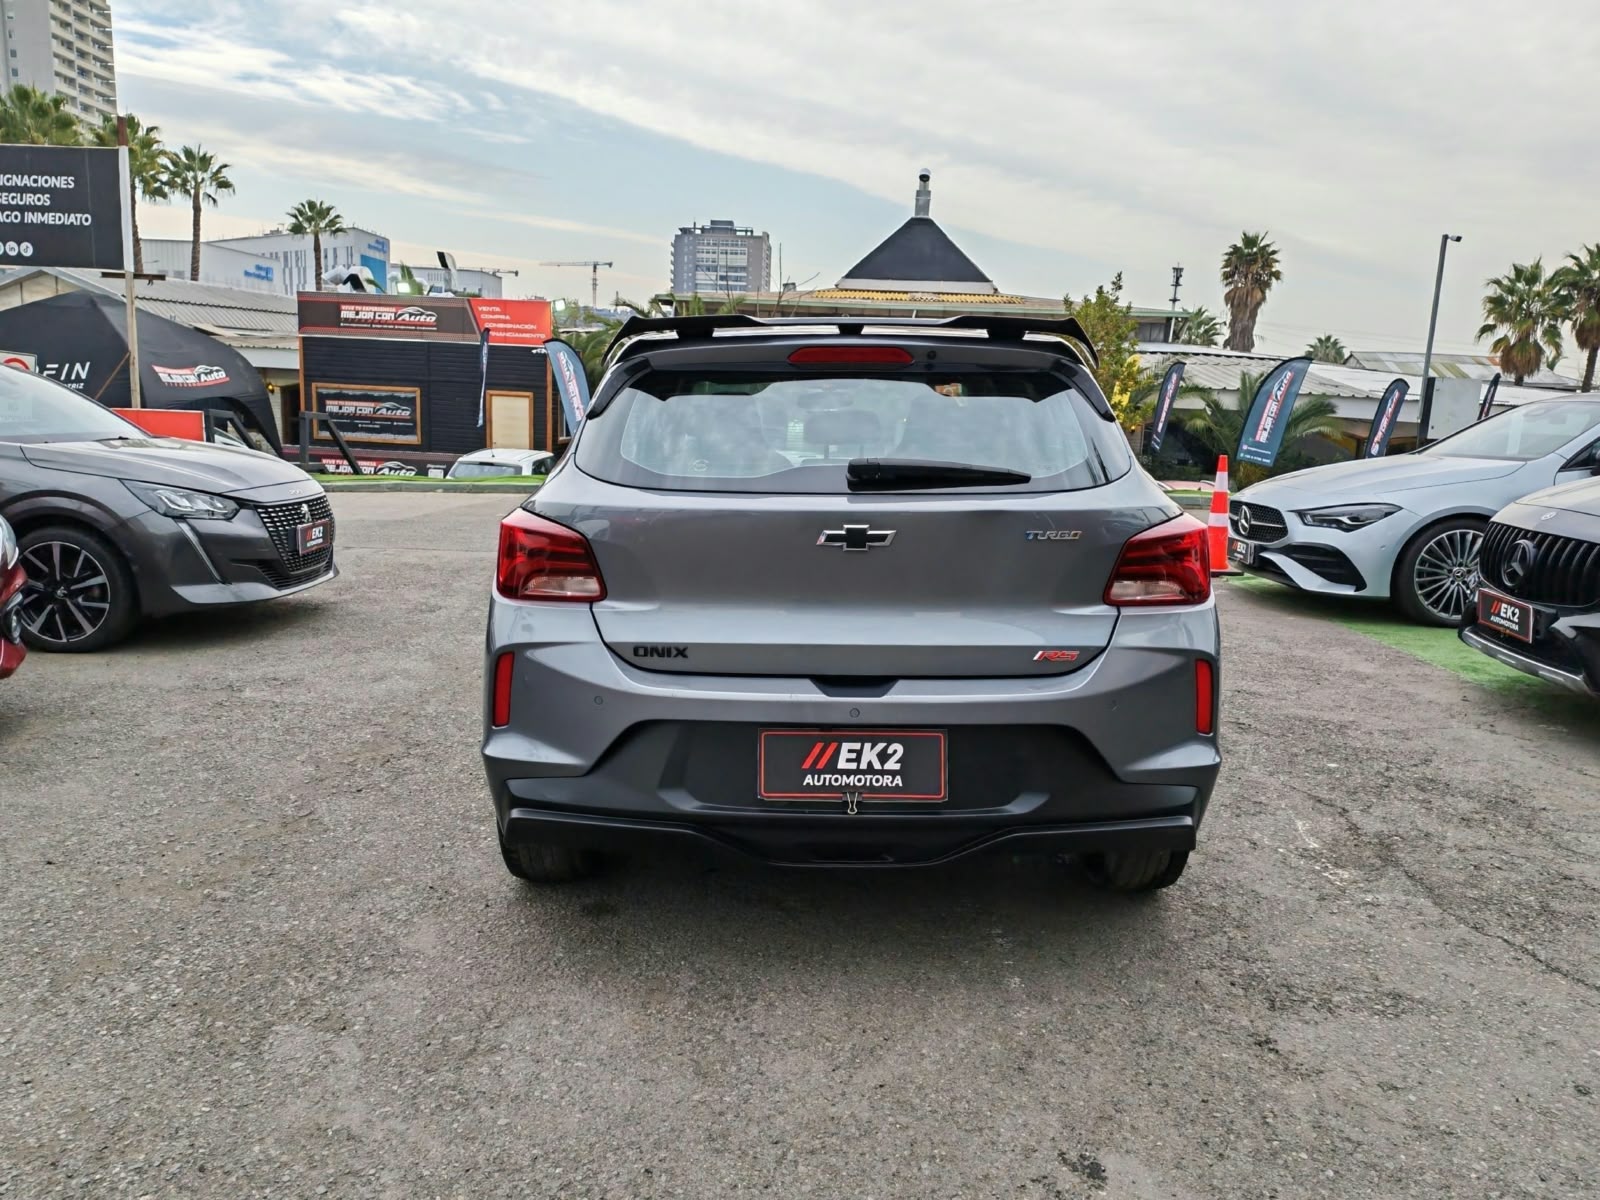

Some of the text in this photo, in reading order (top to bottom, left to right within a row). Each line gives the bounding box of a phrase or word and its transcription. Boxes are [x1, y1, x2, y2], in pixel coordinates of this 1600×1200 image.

[0, 174, 75, 189] IGNACIONES
[0, 192, 51, 206] EGUROS
[24, 211, 92, 226] INMEDIATO
[340, 310, 437, 322] MEJOR CON Auto
[326, 406, 355, 414] MEJOR
[376, 408, 411, 416] Auto
[376, 467, 417, 476] Auto
[633, 646, 688, 658] ONIX
[1033, 650, 1080, 661] RS
[803, 774, 903, 787] AUTOMOTORA
